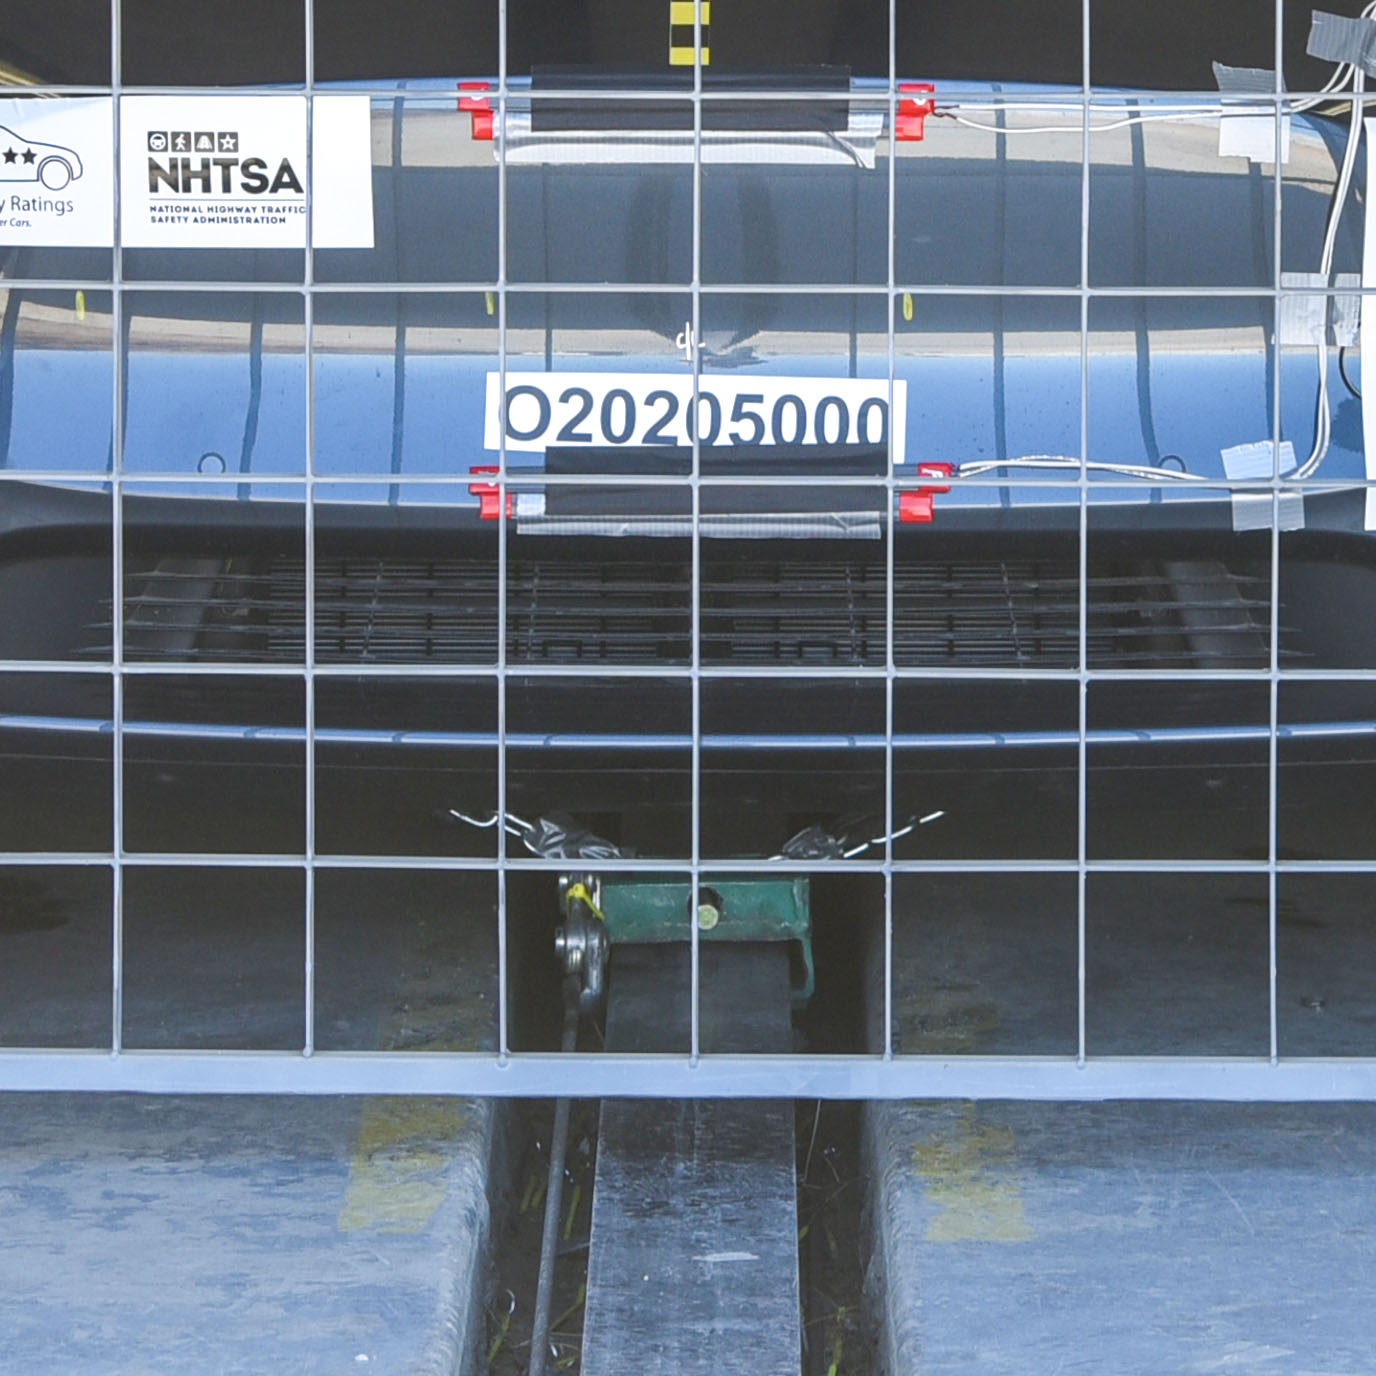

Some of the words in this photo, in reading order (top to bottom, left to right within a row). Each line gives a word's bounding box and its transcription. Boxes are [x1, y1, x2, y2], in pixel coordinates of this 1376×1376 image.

[148, 156, 304, 194] NHTSA
[11, 195, 74, 216] Ratings
[150, 205, 203, 213] NATIONAL
[207, 205, 257, 213] HIGHWAY
[261, 206, 306, 214] TRAFFIC
[151, 215, 188, 224] SAFETY
[193, 216, 286, 224] ADMINISTRATION
